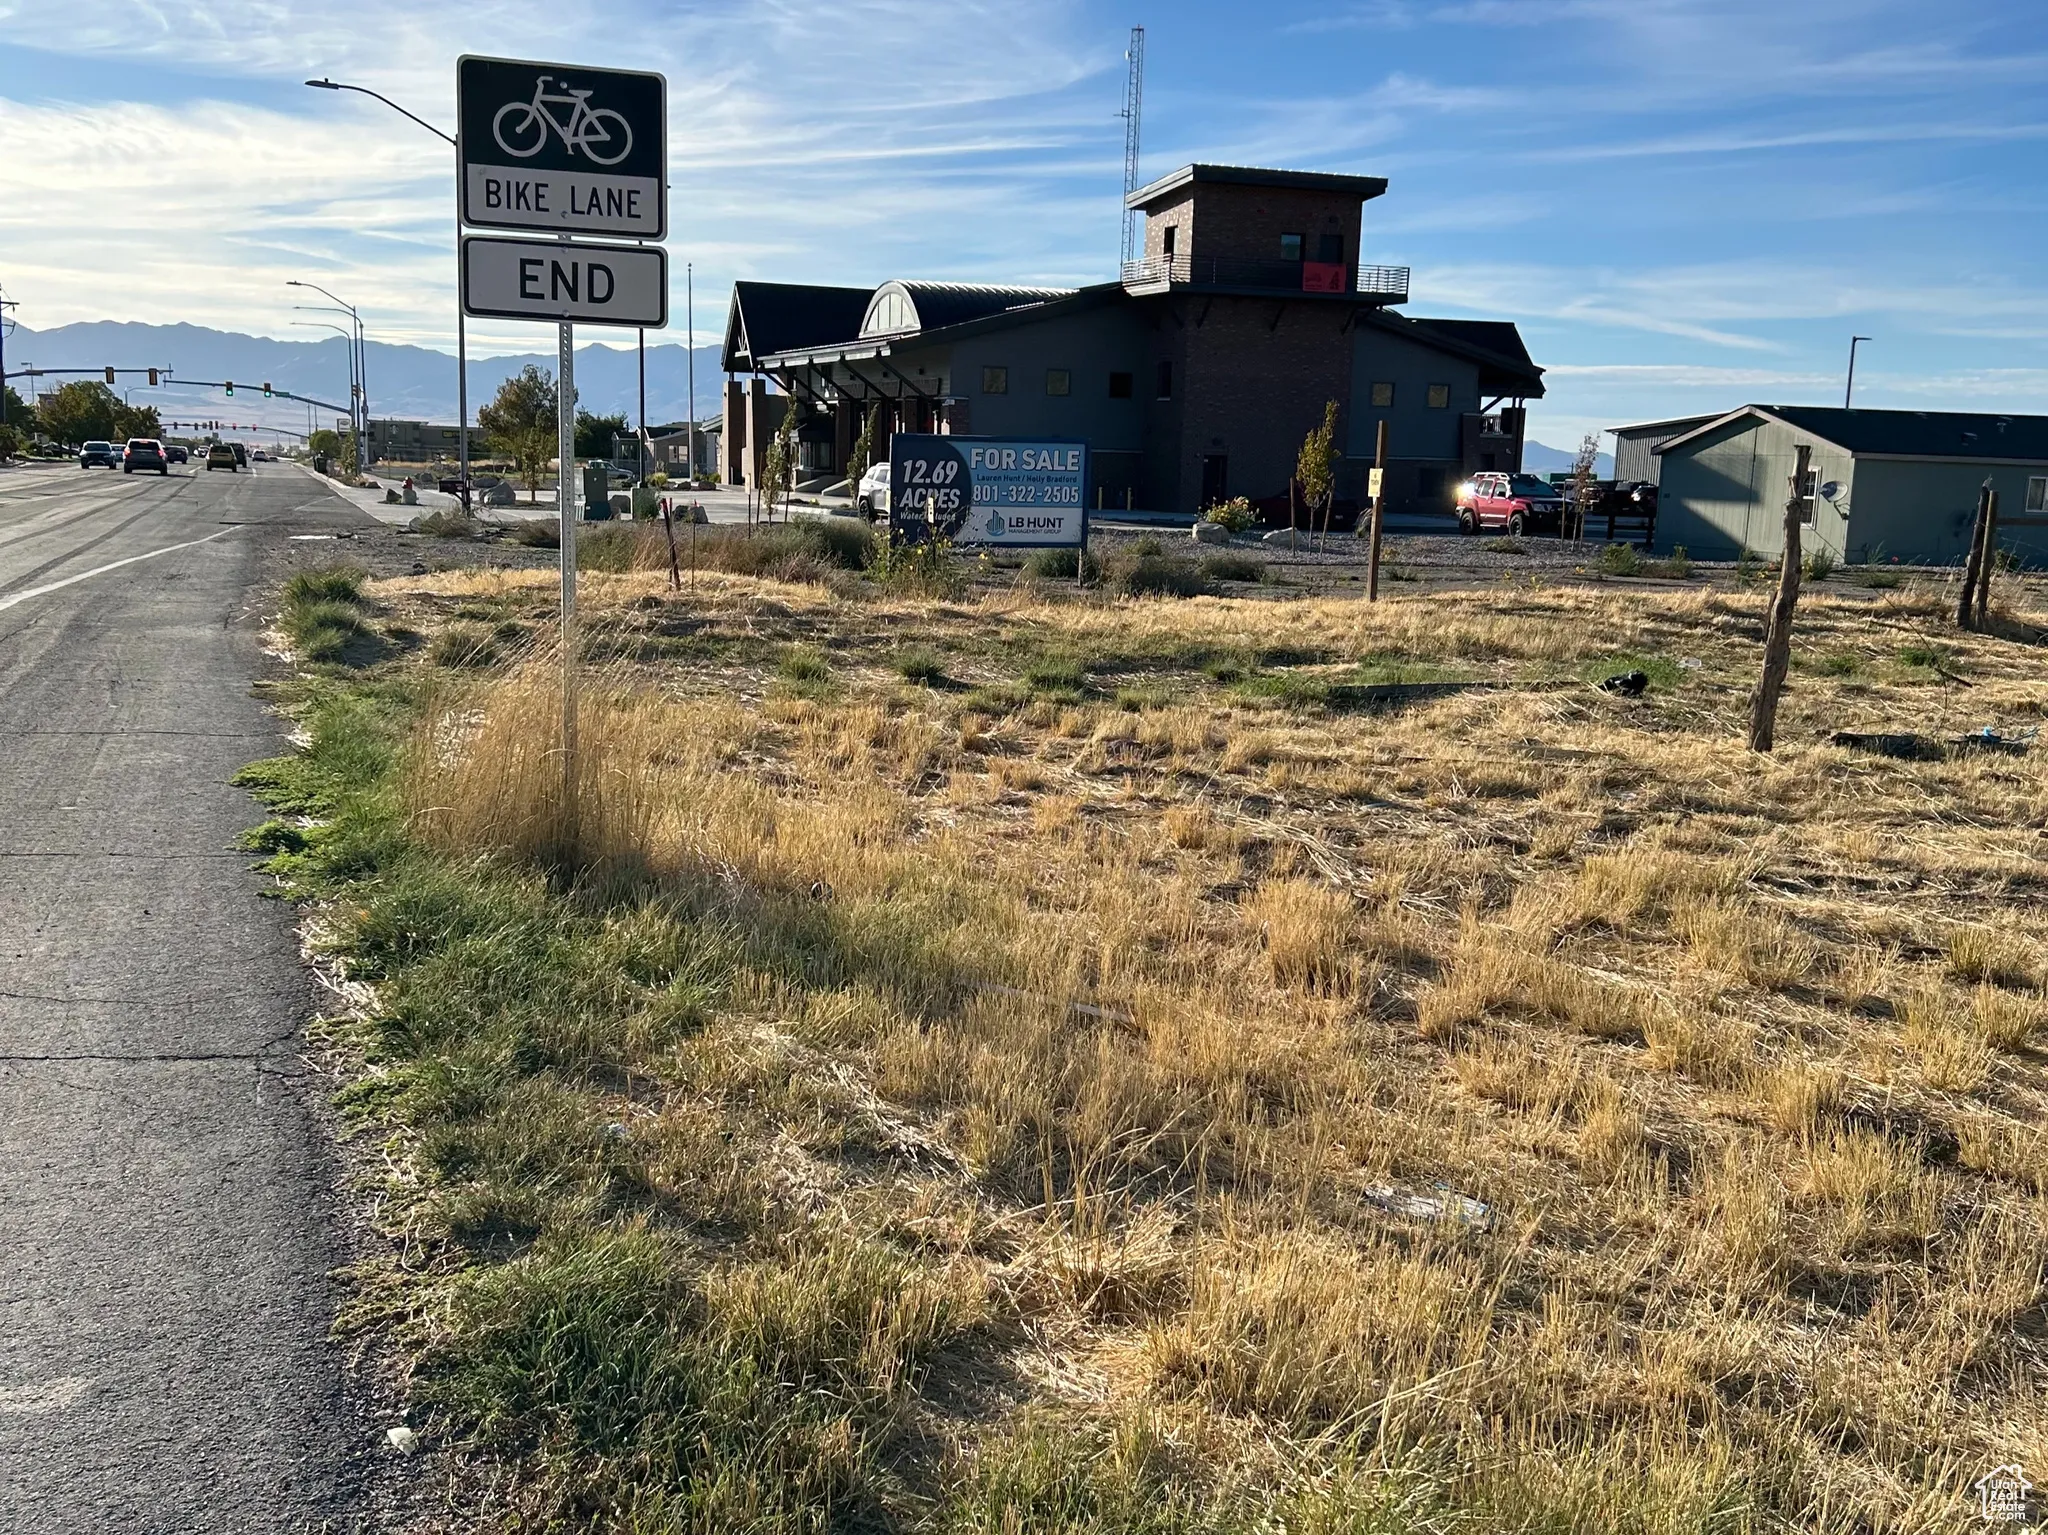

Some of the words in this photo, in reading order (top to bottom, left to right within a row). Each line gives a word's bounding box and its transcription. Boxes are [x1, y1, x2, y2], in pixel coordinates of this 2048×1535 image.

[485, 178, 550, 213] BIKE
[570, 185, 642, 219] LANE
[519, 257, 615, 304] END
[970, 448, 1017, 471] FOR
[1022, 449, 1080, 471] SALE
[903, 459, 959, 484] 12.69
[977, 474, 1002, 482] Lauren
[1003, 474, 1021, 482] Hunt
[1046, 475, 1077, 483] Bradford
[899, 487, 961, 509] ACRES
[973, 484, 1079, 503] 801-322-2505
[900, 511, 923, 520] Water
[1008, 516, 1025, 528] LB
[1027, 517, 1065, 529] HUNT
